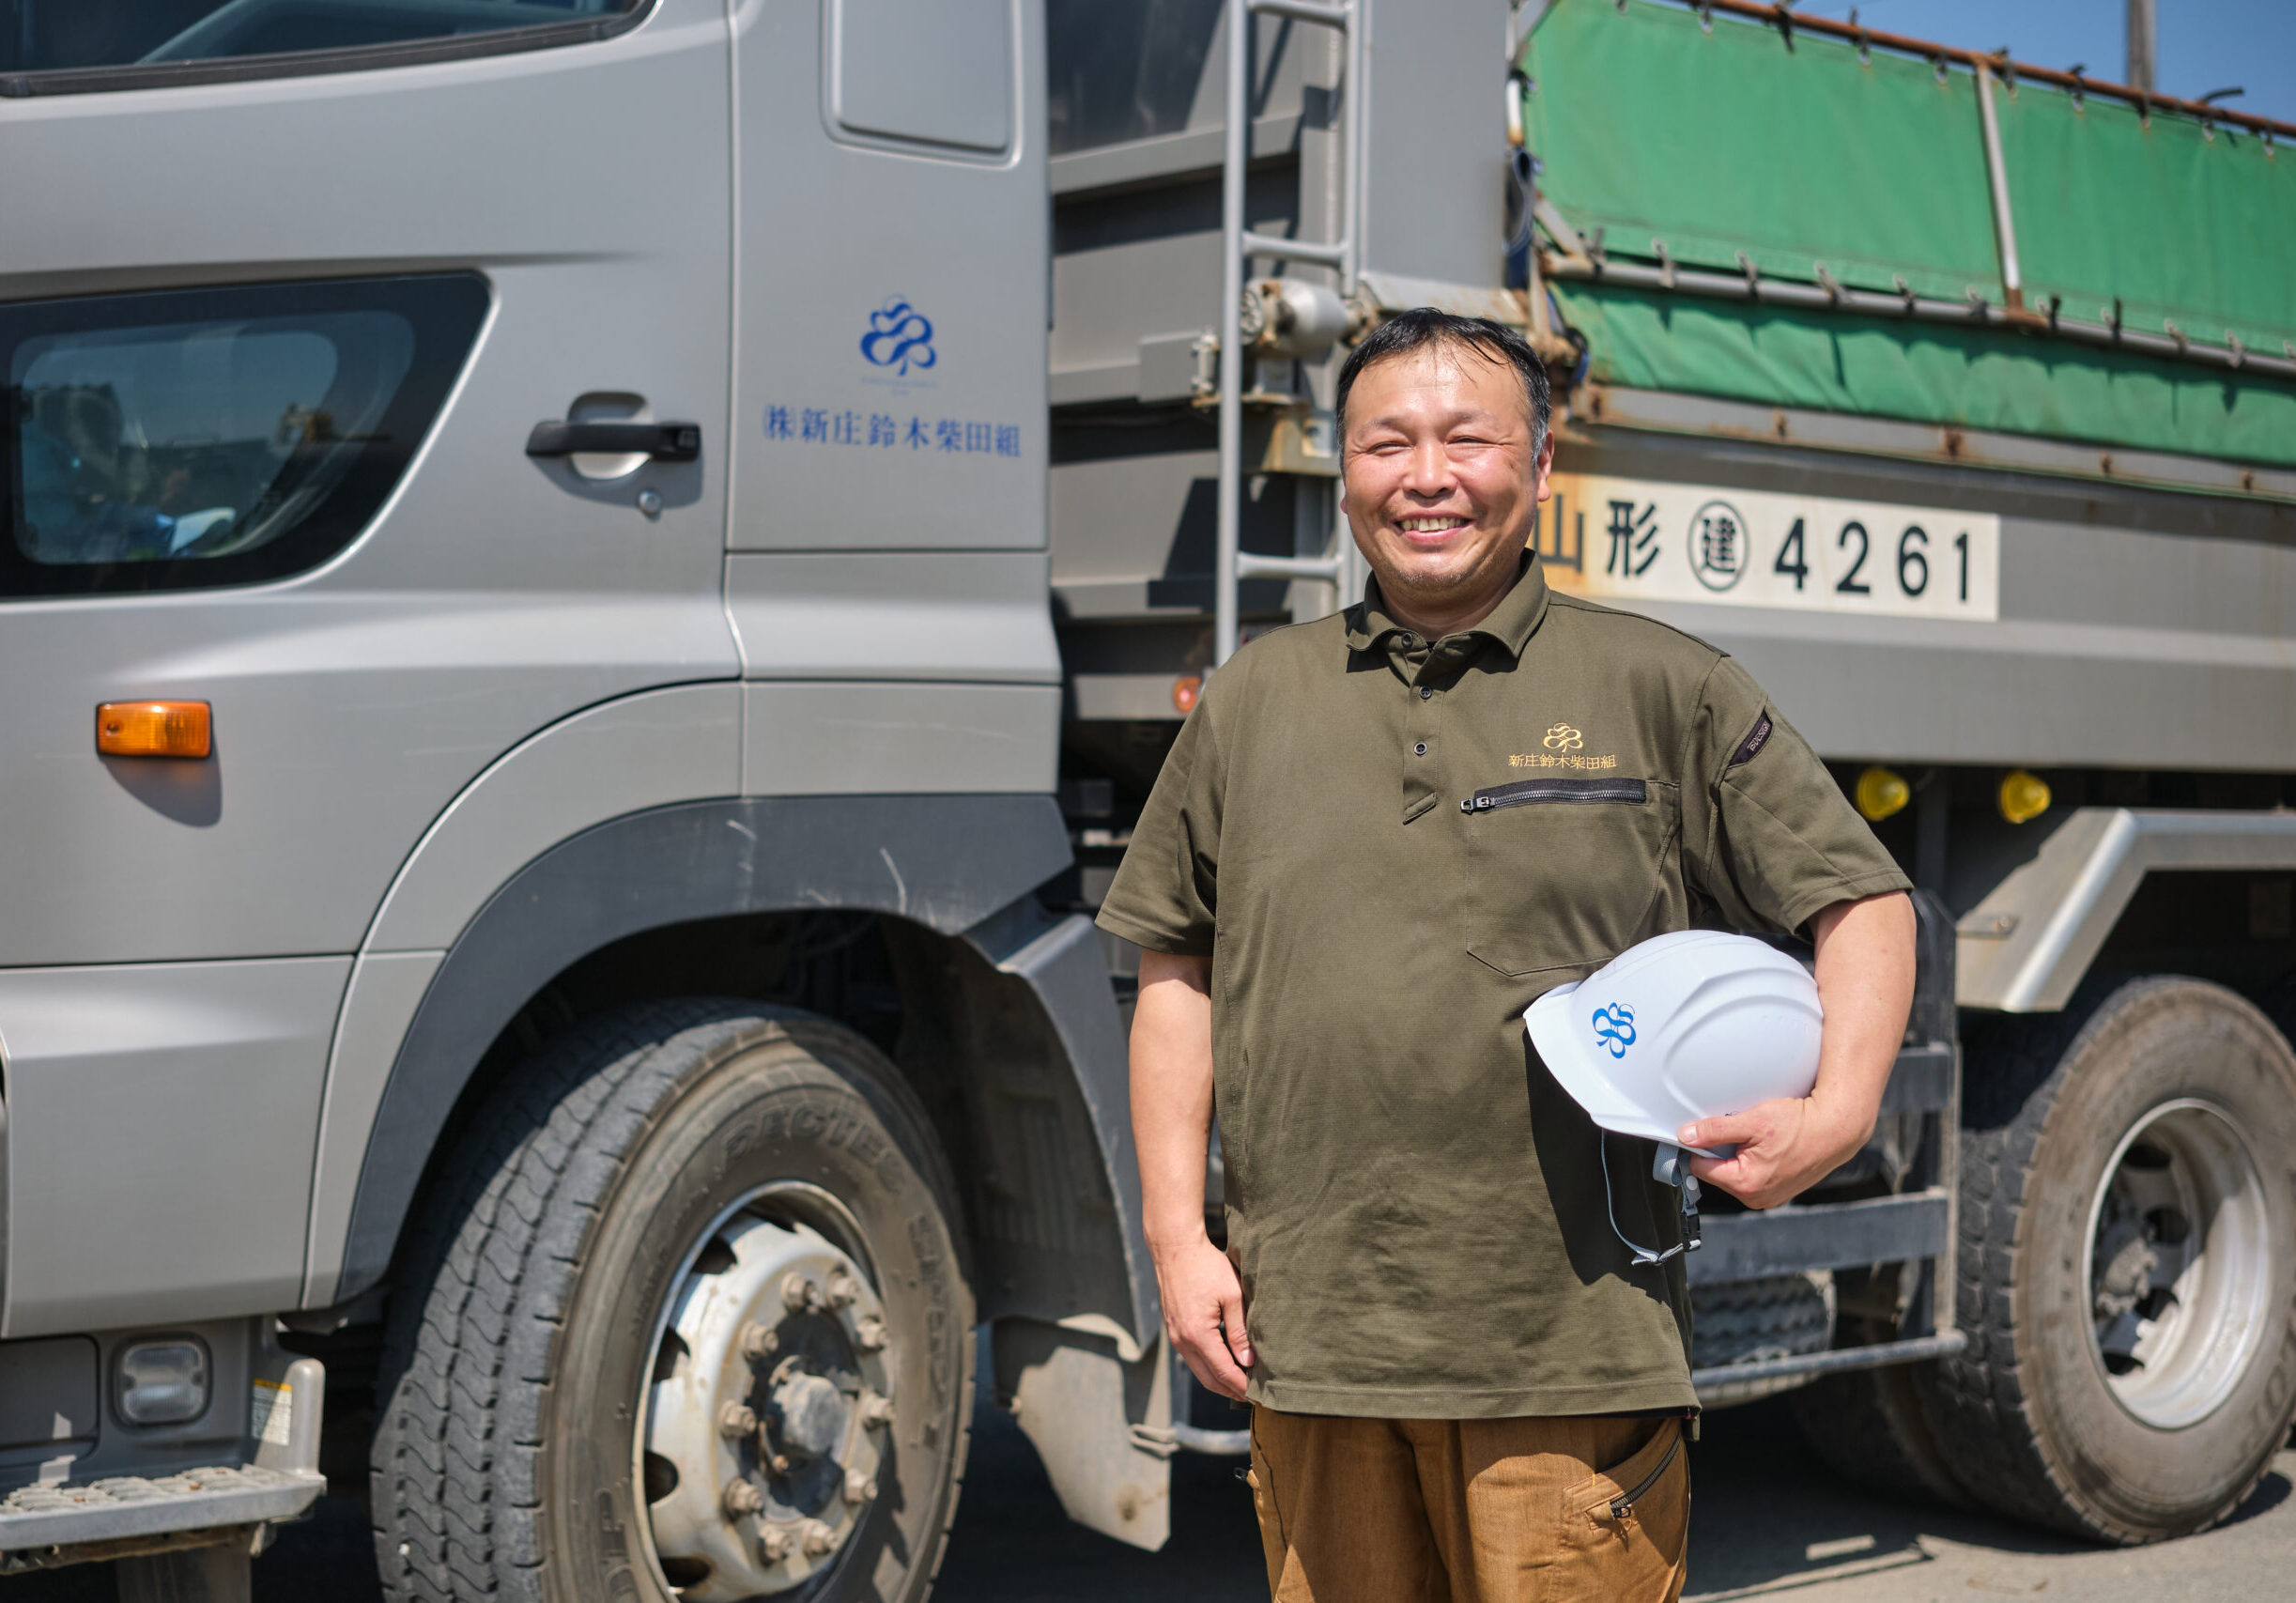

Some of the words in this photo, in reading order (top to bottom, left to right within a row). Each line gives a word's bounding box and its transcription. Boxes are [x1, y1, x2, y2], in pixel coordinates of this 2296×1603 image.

[1773, 516, 1970, 604] 4261
[1508, 754, 1616, 769] 新庄鈴木柴田組
